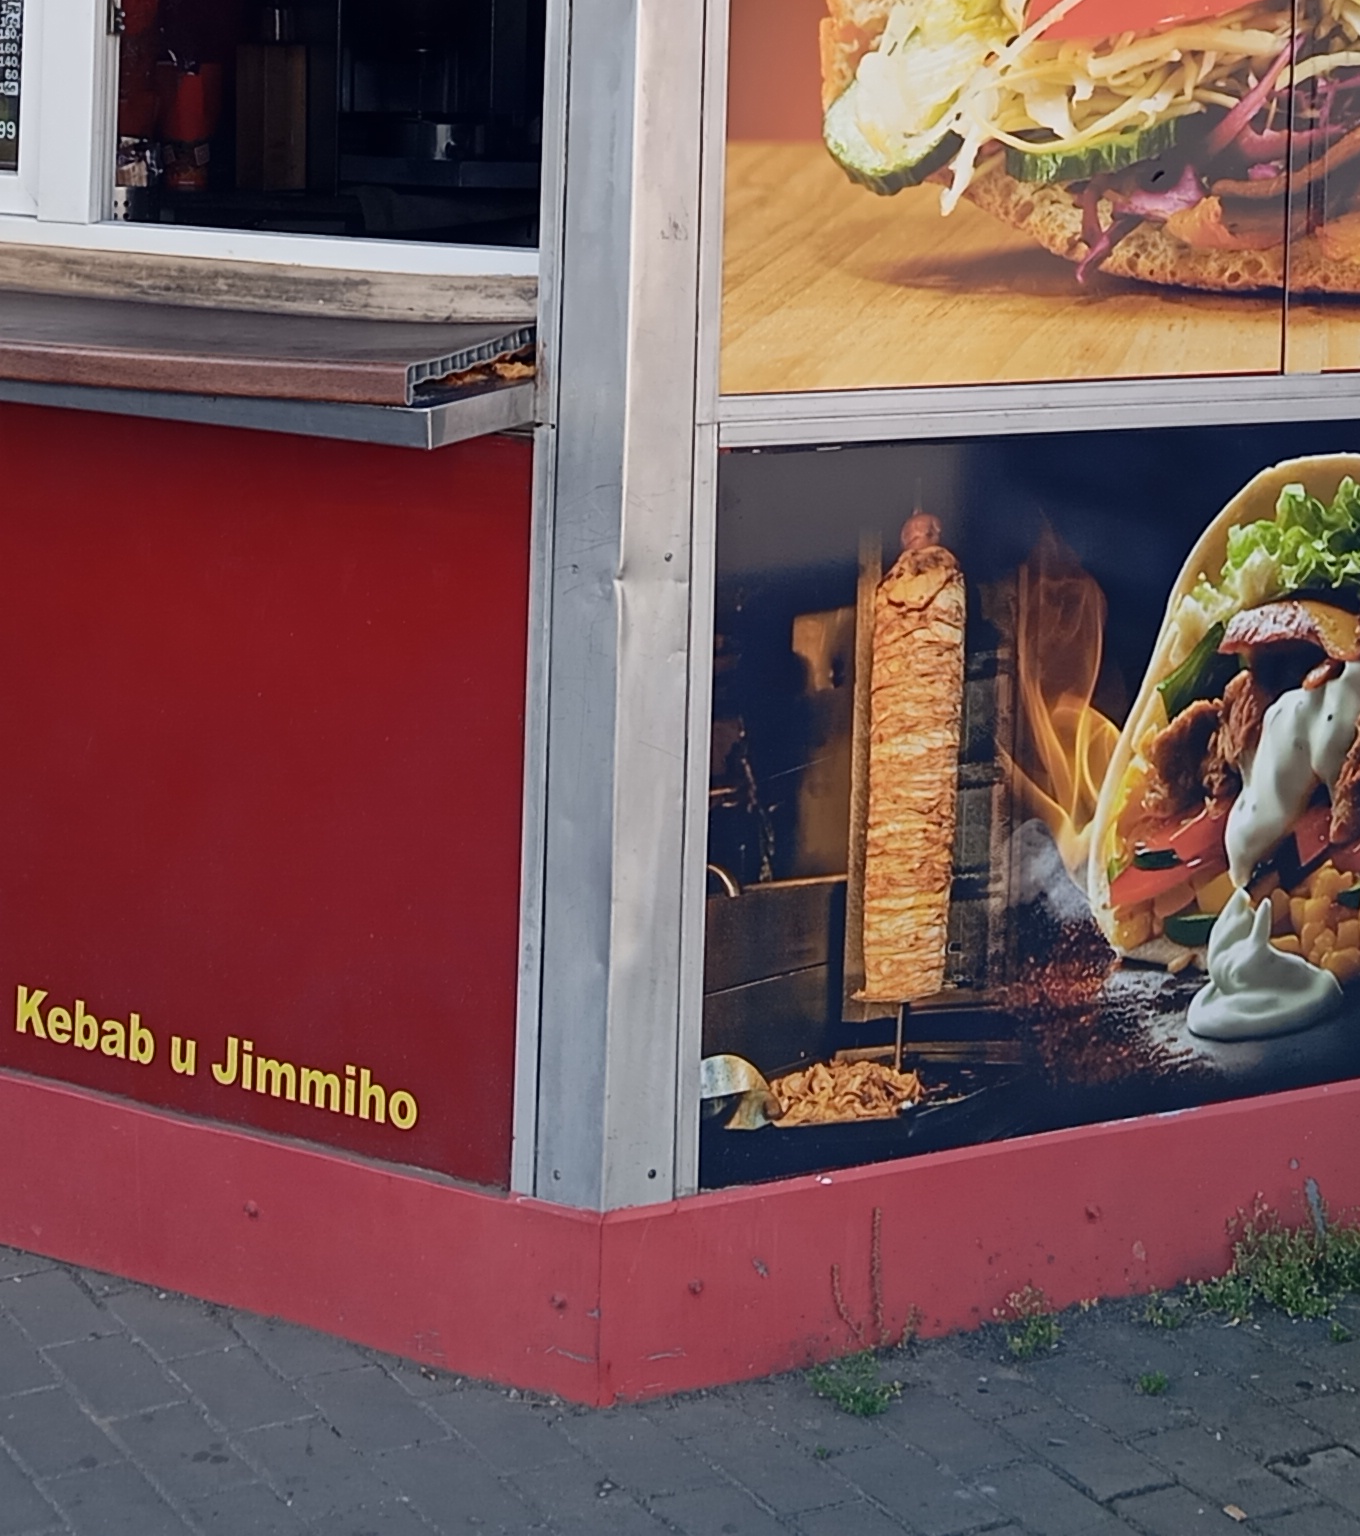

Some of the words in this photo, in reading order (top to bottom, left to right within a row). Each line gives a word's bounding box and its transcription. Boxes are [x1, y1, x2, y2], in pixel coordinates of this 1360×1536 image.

[15, 984, 155, 1066] Kebab
[171, 1034, 196, 1077] u
[211, 1036, 419, 1132] Jimmiho
